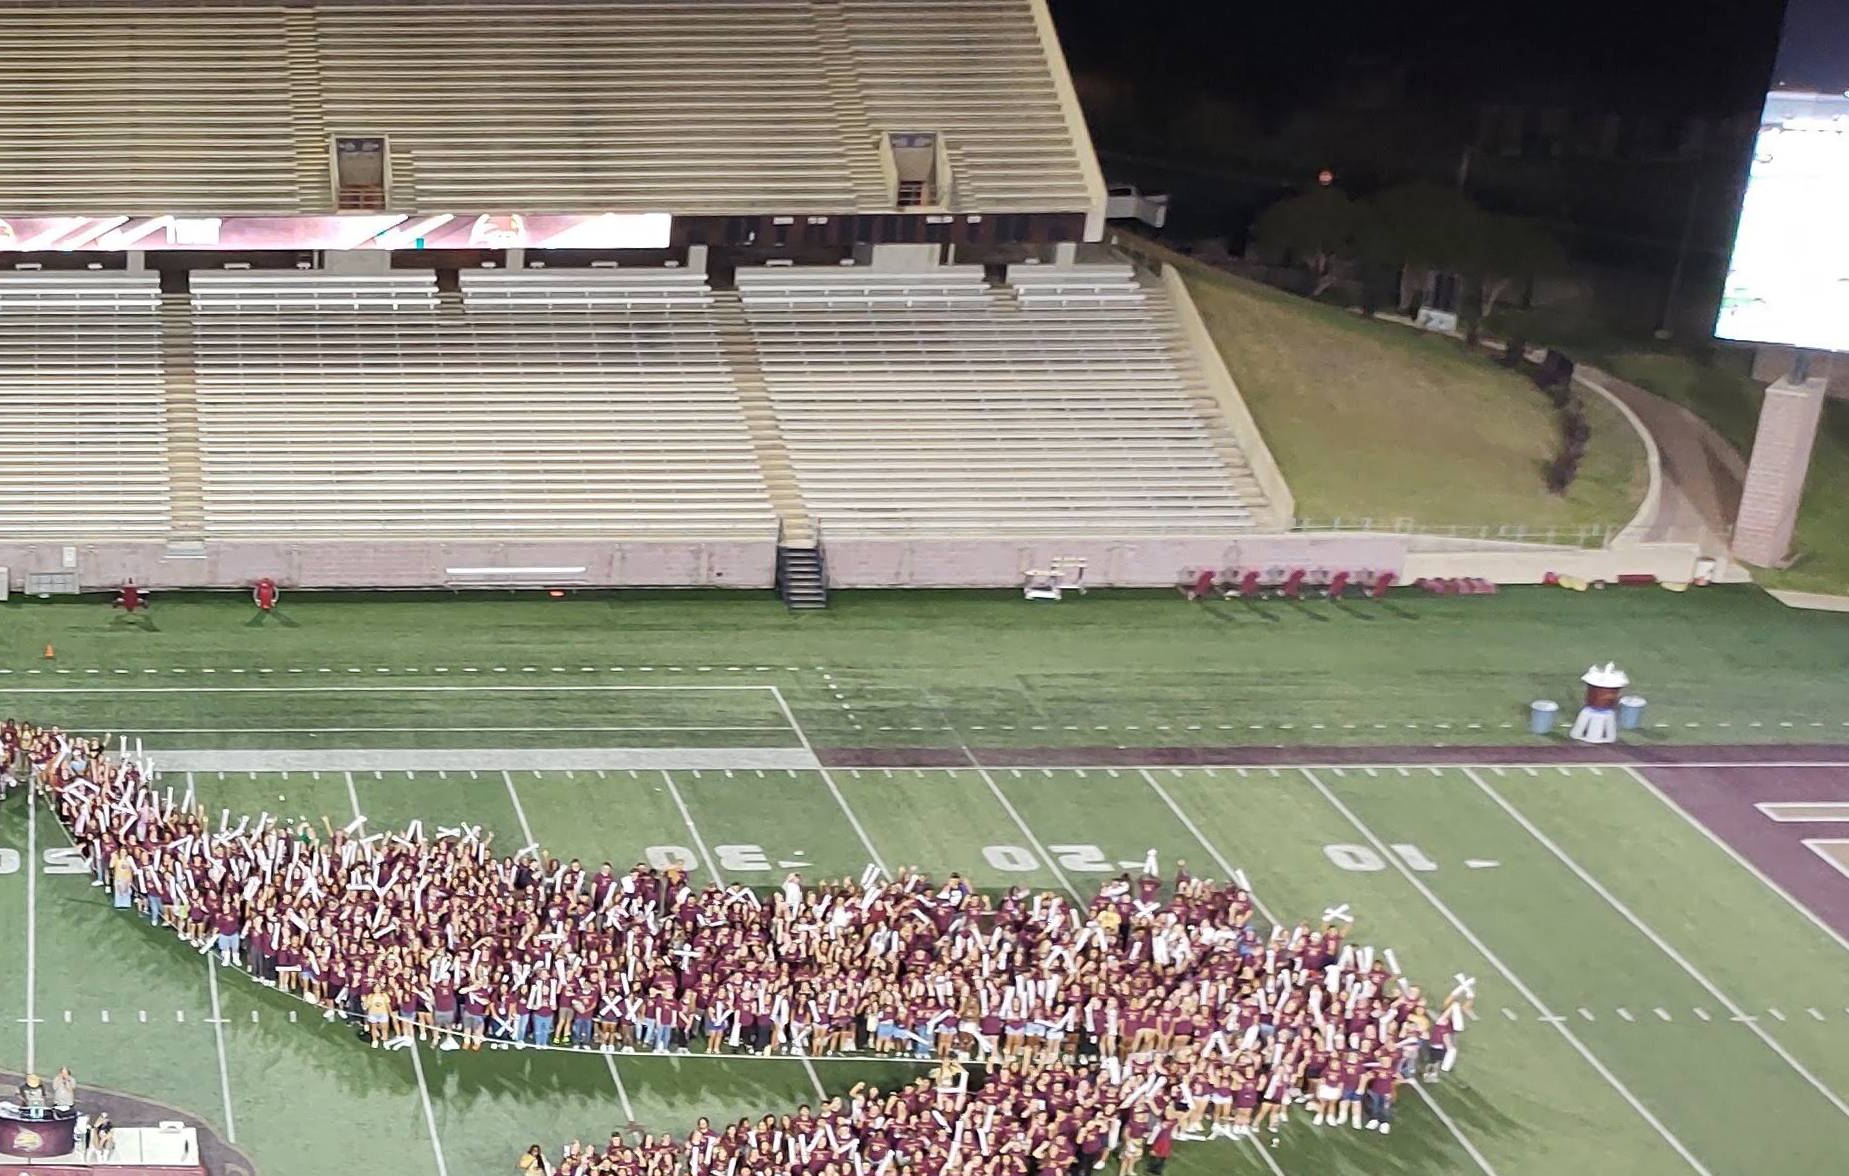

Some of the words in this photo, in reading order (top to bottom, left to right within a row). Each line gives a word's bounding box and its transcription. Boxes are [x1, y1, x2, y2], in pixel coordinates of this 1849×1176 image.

[645, 845, 772, 872] 30
[982, 845, 1111, 872] 20
[1323, 844, 1438, 871] 10
